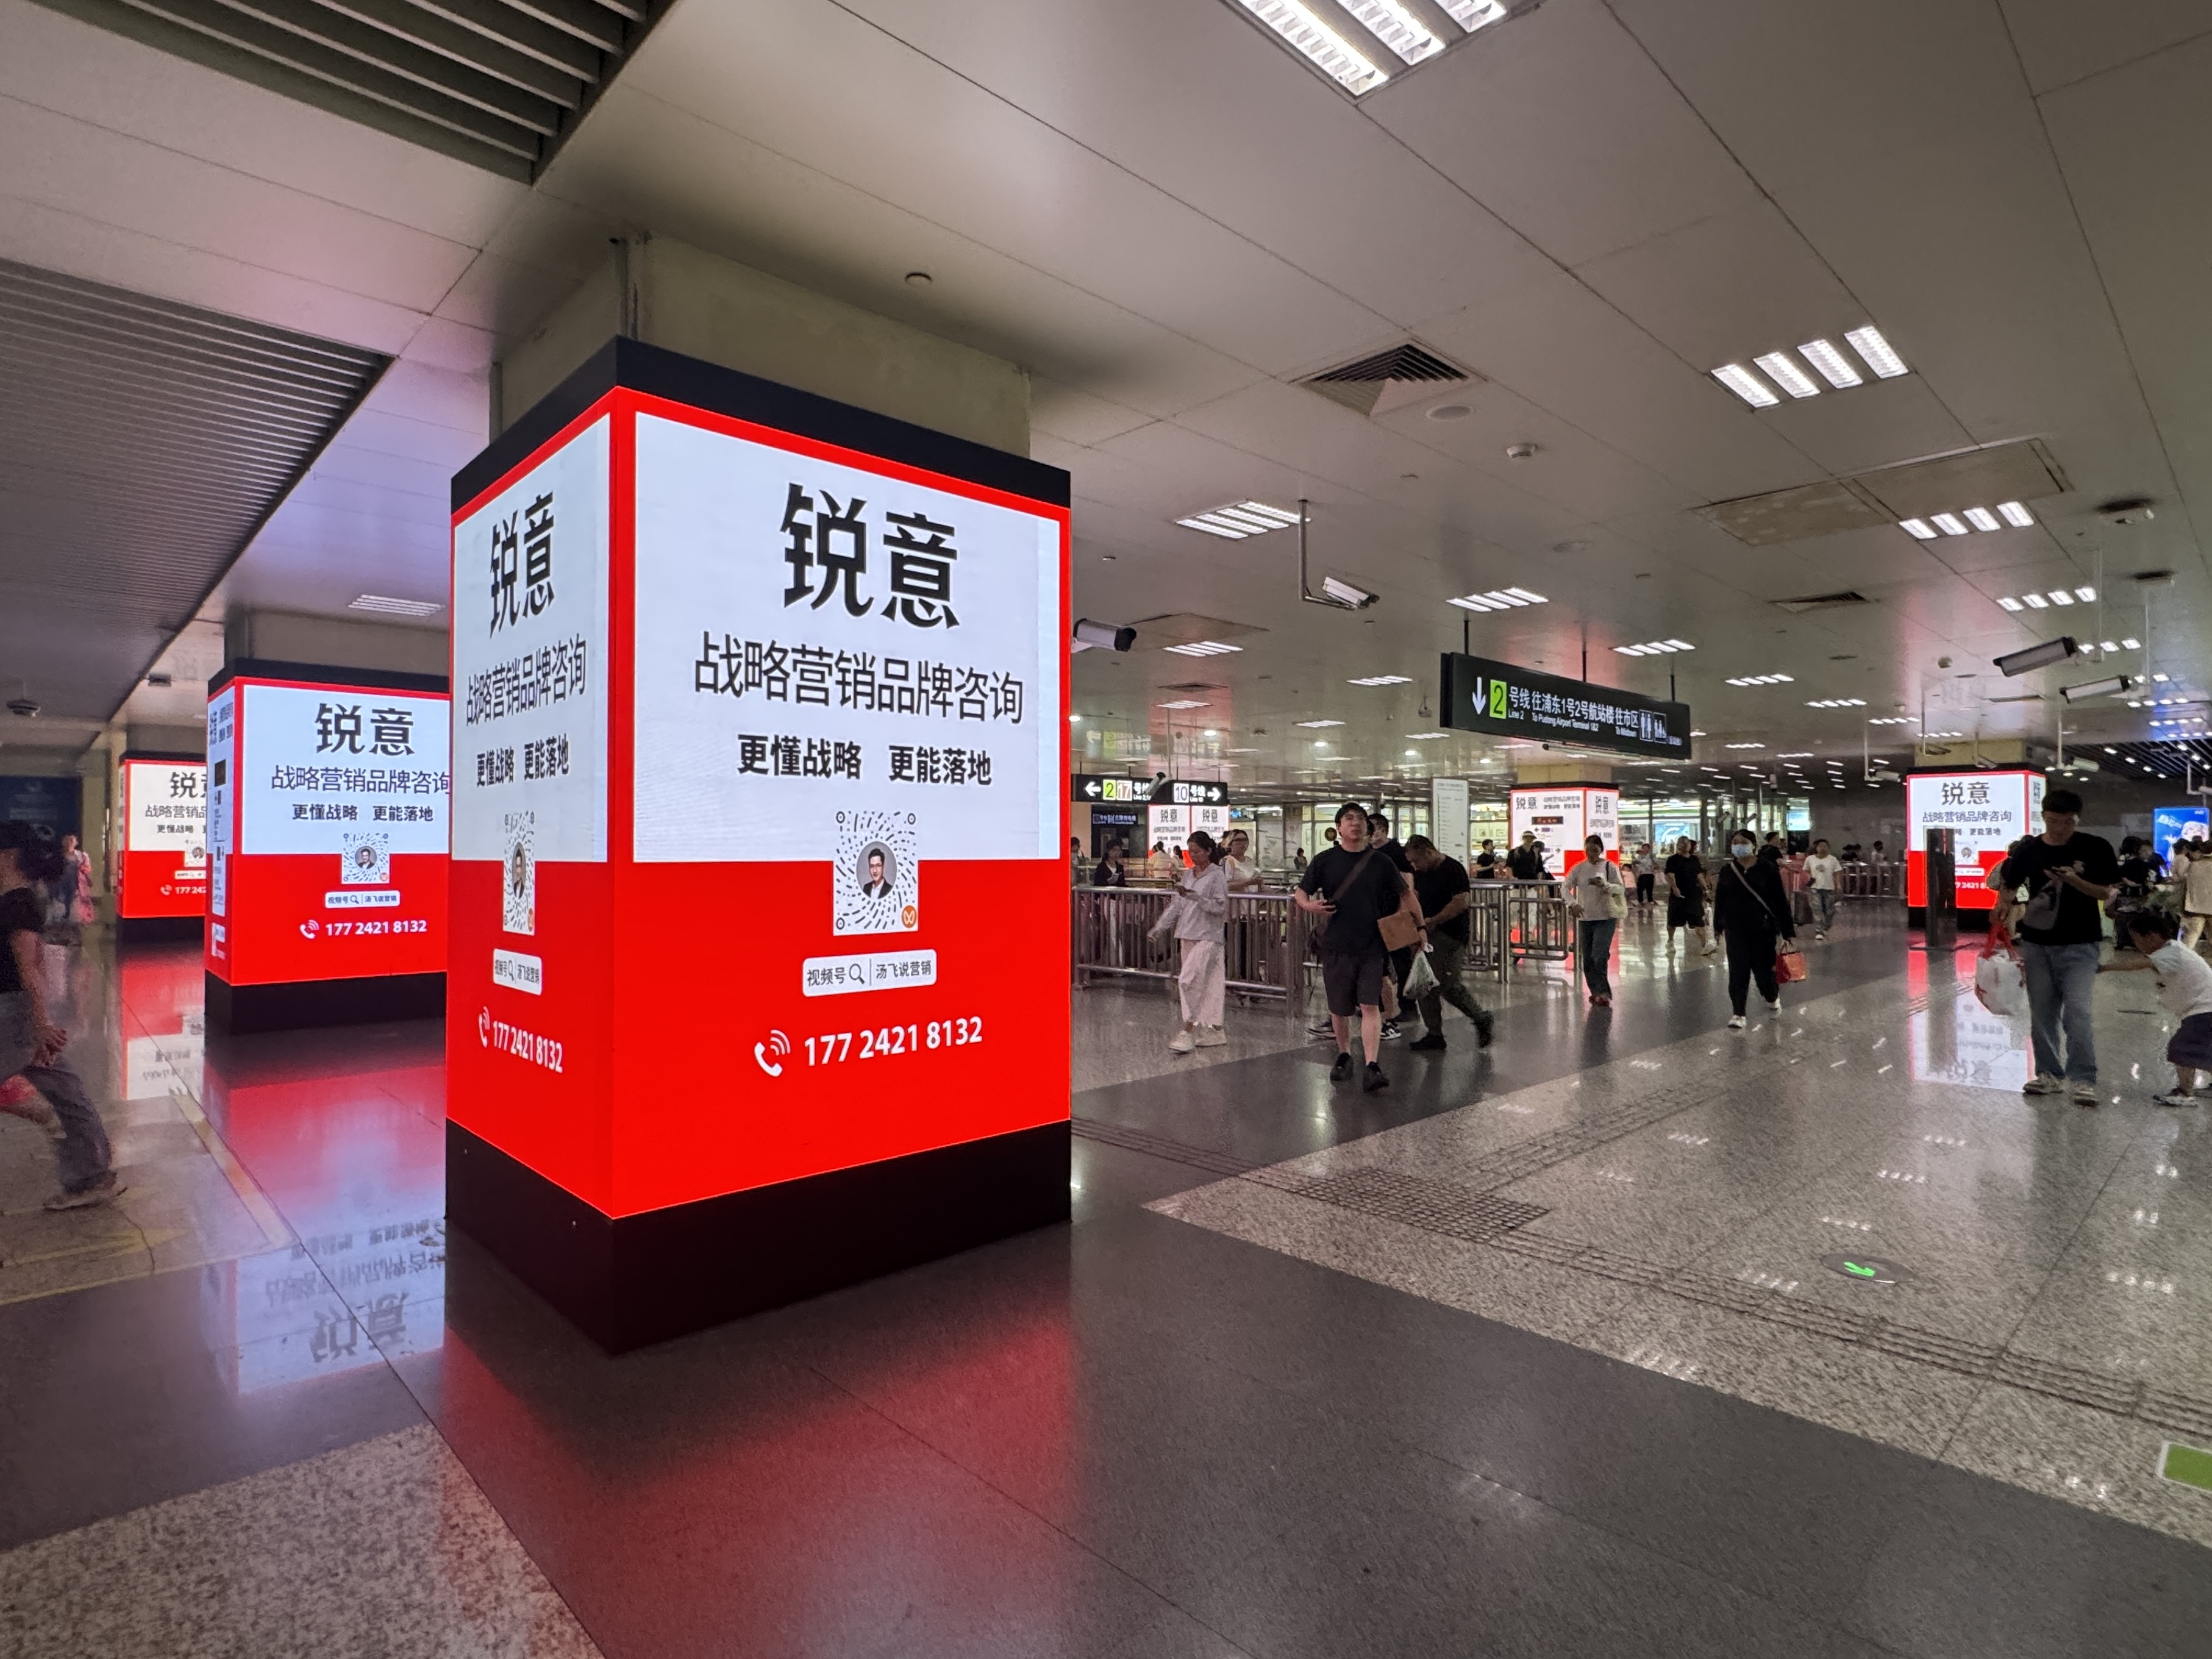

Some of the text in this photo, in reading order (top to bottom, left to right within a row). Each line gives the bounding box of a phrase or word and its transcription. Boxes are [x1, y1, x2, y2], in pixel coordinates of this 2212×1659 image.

[490, 491, 555, 638] 锐意
[780, 482, 960, 629] 锐意
[466, 633, 587, 726] 战略营销品牌咨询
[694, 631, 1024, 724] 战略营销品牌咨询
[1493, 685, 1504, 715] 2
[1508, 686, 1530, 710] 号线
[1615, 706, 1639, 729] 往市区
[1508, 708, 1524, 719] Line 2
[315, 702, 415, 756] 锐意
[477, 733, 569, 787] 更懂战略 更能落地
[737, 734, 992, 786] 更懂战略 更能落地
[169, 771, 206, 799] 锐
[271, 765, 449, 795] 战略营销品牌咨询
[1105, 782, 1113, 797] 2
[1118, 783, 1131, 799] 17
[1176, 783, 1188, 801] 10
[1941, 782, 1990, 805] 锐意
[292, 803, 433, 822] 更懂战略 更能落地
[1922, 810, 2012, 823] 战略营销品牌咨询
[326, 919, 427, 936] 177 2421 8132
[807, 960, 932, 987] 视频号 汤飞说营销
[493, 1021, 563, 1073] 177 2421 8132
[804, 1016, 983, 1067] 177 2421 8132
